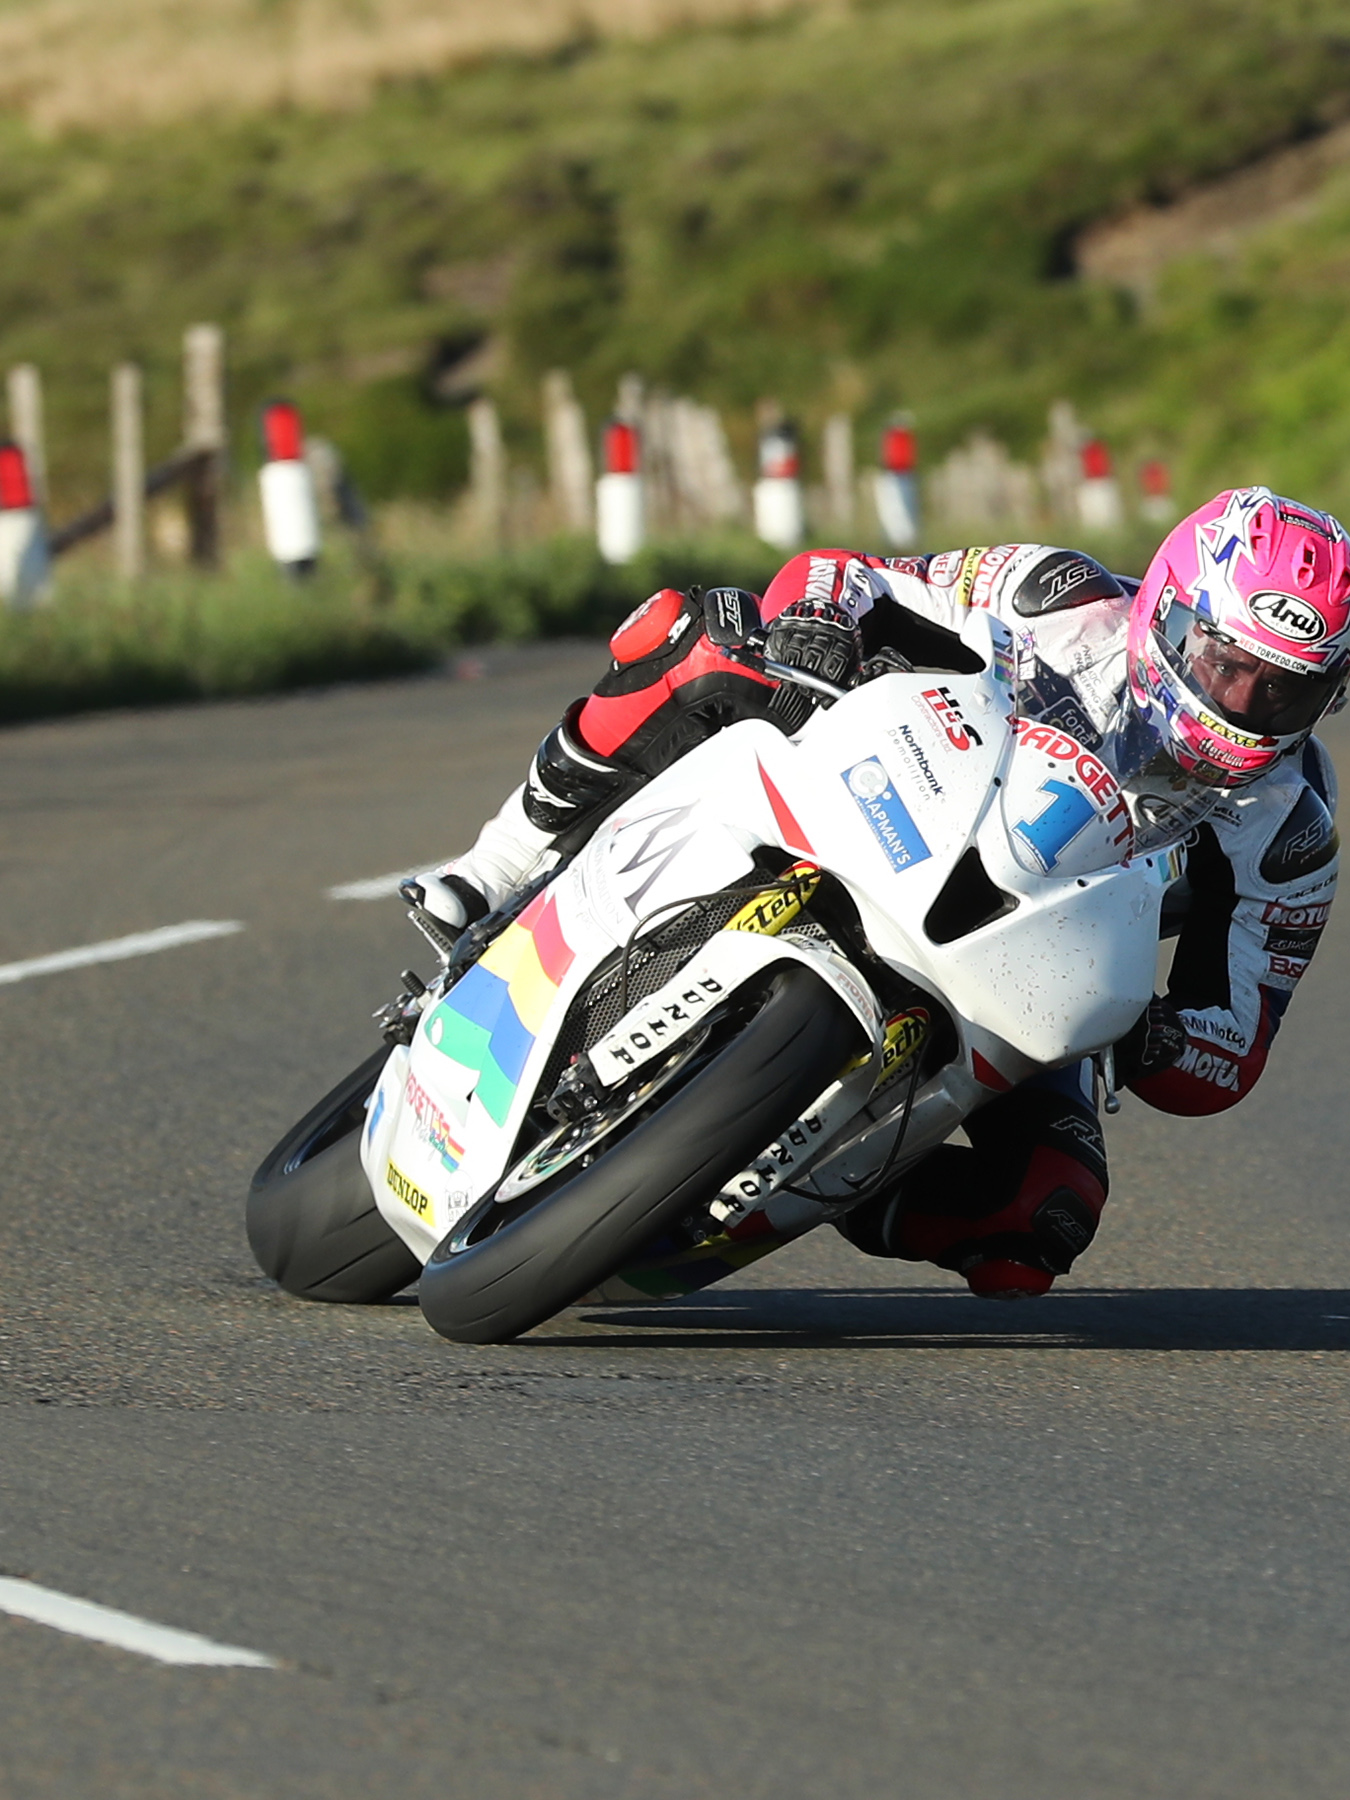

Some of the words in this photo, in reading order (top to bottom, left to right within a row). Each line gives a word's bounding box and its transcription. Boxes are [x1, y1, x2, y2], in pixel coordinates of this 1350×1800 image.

[1252, 597, 1319, 633] Arai
[1237, 634, 1255, 651] RED
[1255, 645, 1309, 673] TORPEDO.COM
[911, 694, 943, 738] Contractors
[920, 686, 984, 752] H&S
[1197, 710, 1258, 749] WATTS
[886, 728, 931, 801] Demolition
[898, 723, 945, 796] Northbank
[1011, 778, 1098, 874] 1
[609, 977, 723, 1065] DUNLOP
[386, 1162, 428, 1216] DUNLOP
[719, 1114, 823, 1214] DUNLOP
